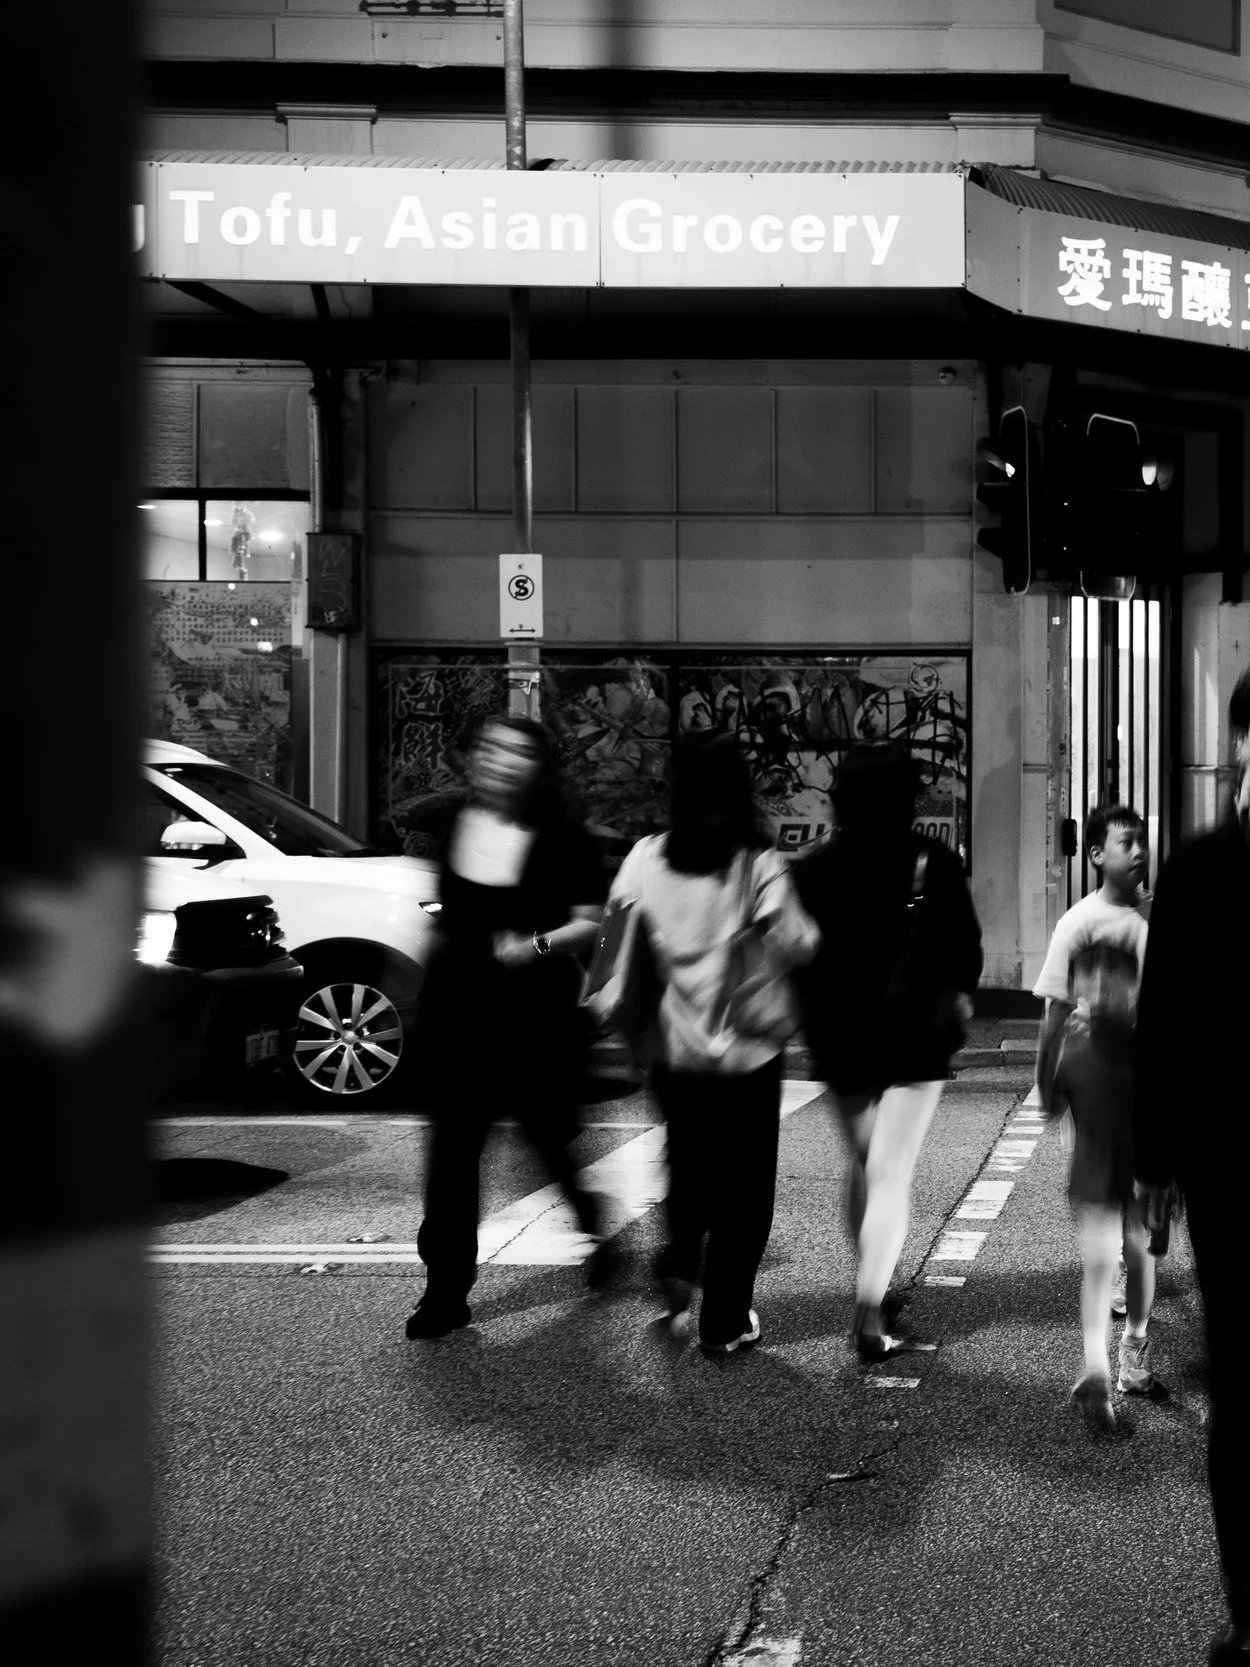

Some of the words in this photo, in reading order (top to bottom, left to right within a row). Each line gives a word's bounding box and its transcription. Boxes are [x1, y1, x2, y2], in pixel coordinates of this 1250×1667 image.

[169, 190, 363, 255] Tofu,
[383, 194, 589, 252] Asian
[611, 197, 901, 266] Grocery
